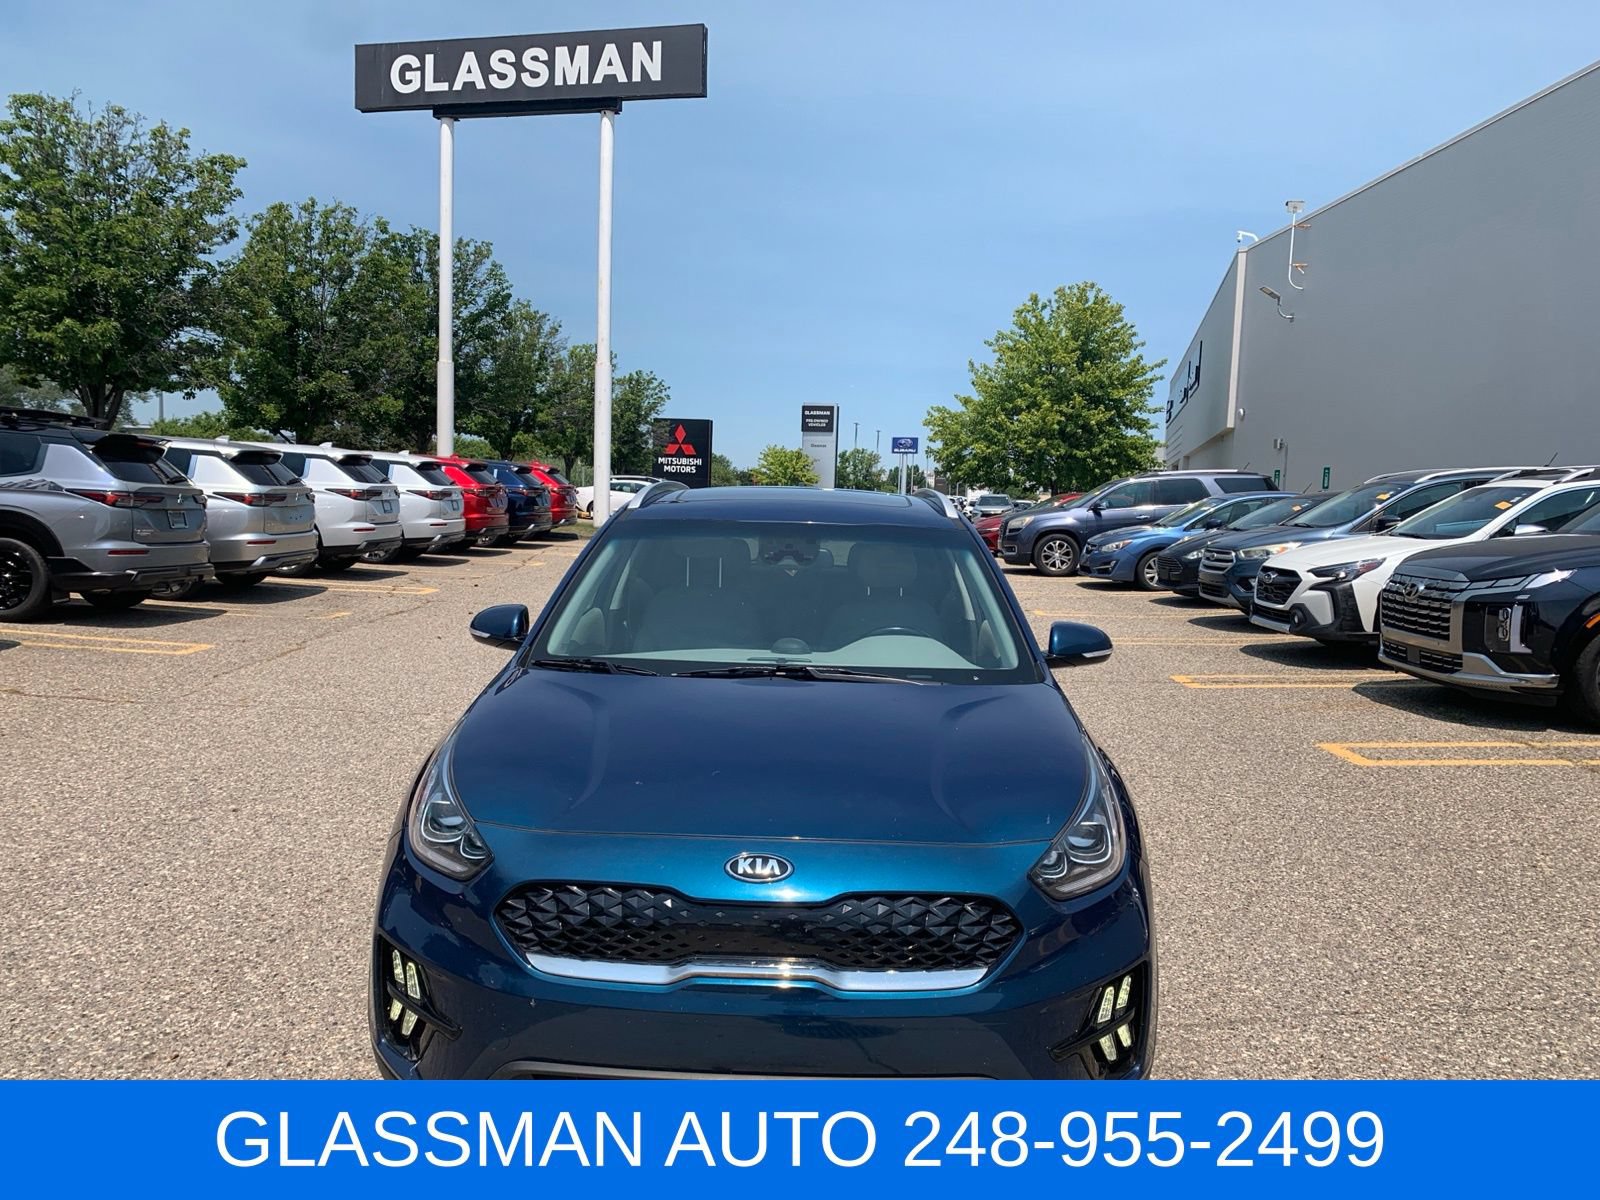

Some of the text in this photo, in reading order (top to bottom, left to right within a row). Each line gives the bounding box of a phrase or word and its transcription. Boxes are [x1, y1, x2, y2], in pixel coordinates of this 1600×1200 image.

[390, 40, 662, 93] GLASSMAN
[658, 457, 702, 466] MITSUBISHI
[663, 465, 697, 474] MOTORS
[737, 858, 781, 876] KIA
